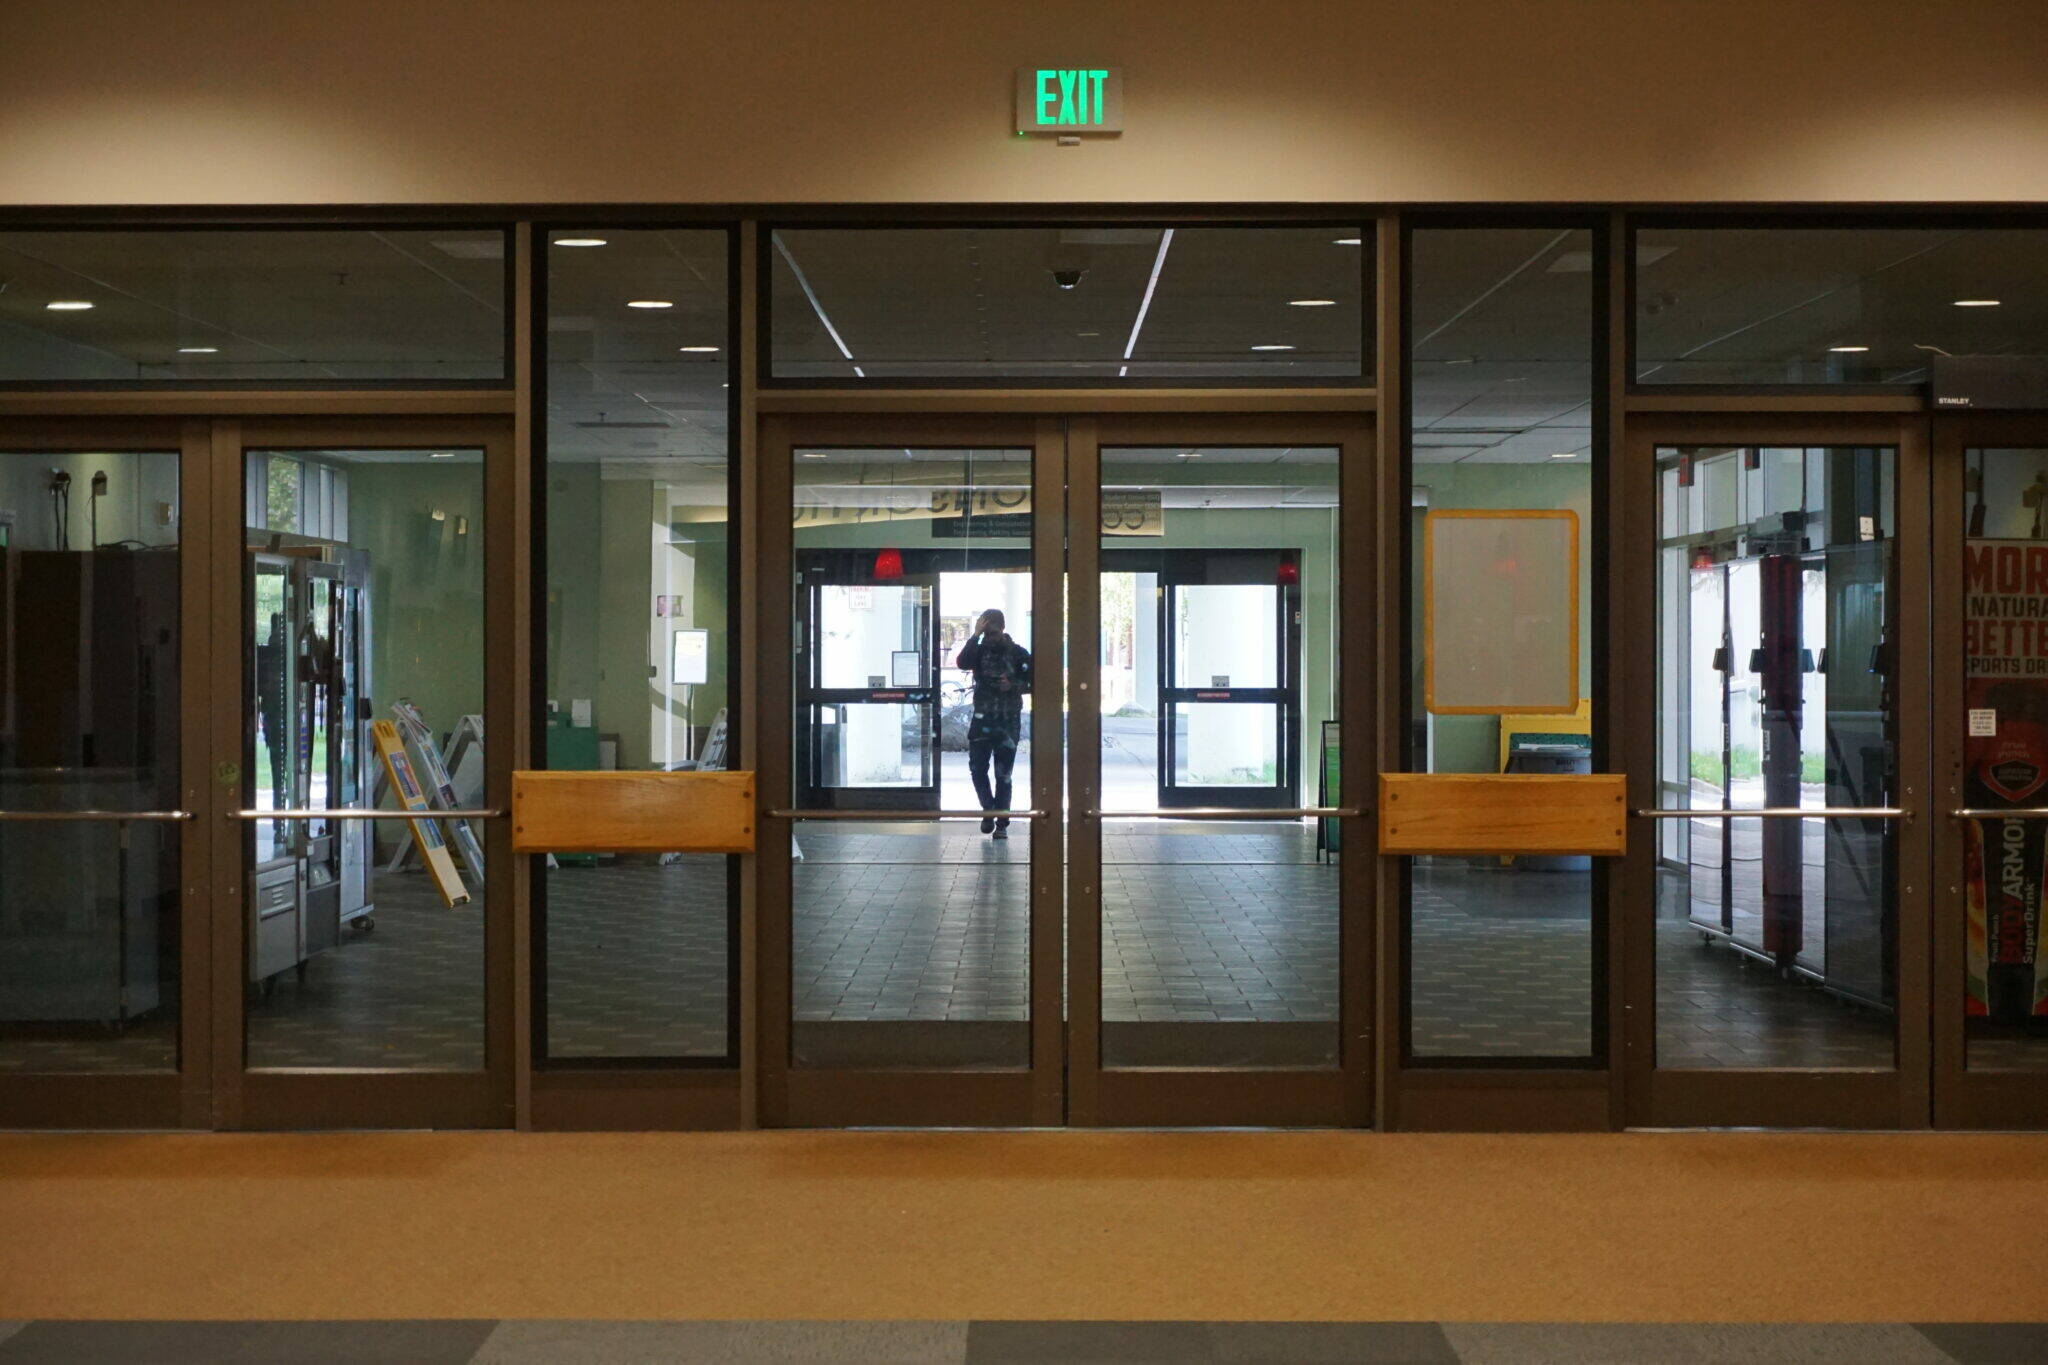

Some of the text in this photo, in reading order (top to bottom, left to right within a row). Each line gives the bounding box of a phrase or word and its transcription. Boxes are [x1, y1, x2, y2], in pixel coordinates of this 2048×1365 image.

[1036, 70, 1108, 125] EXIT
[1938, 397, 1970, 405] STANLEY
[1967, 657, 2020, 674] PORTS
[2022, 882, 2036, 965] SuperDrink
